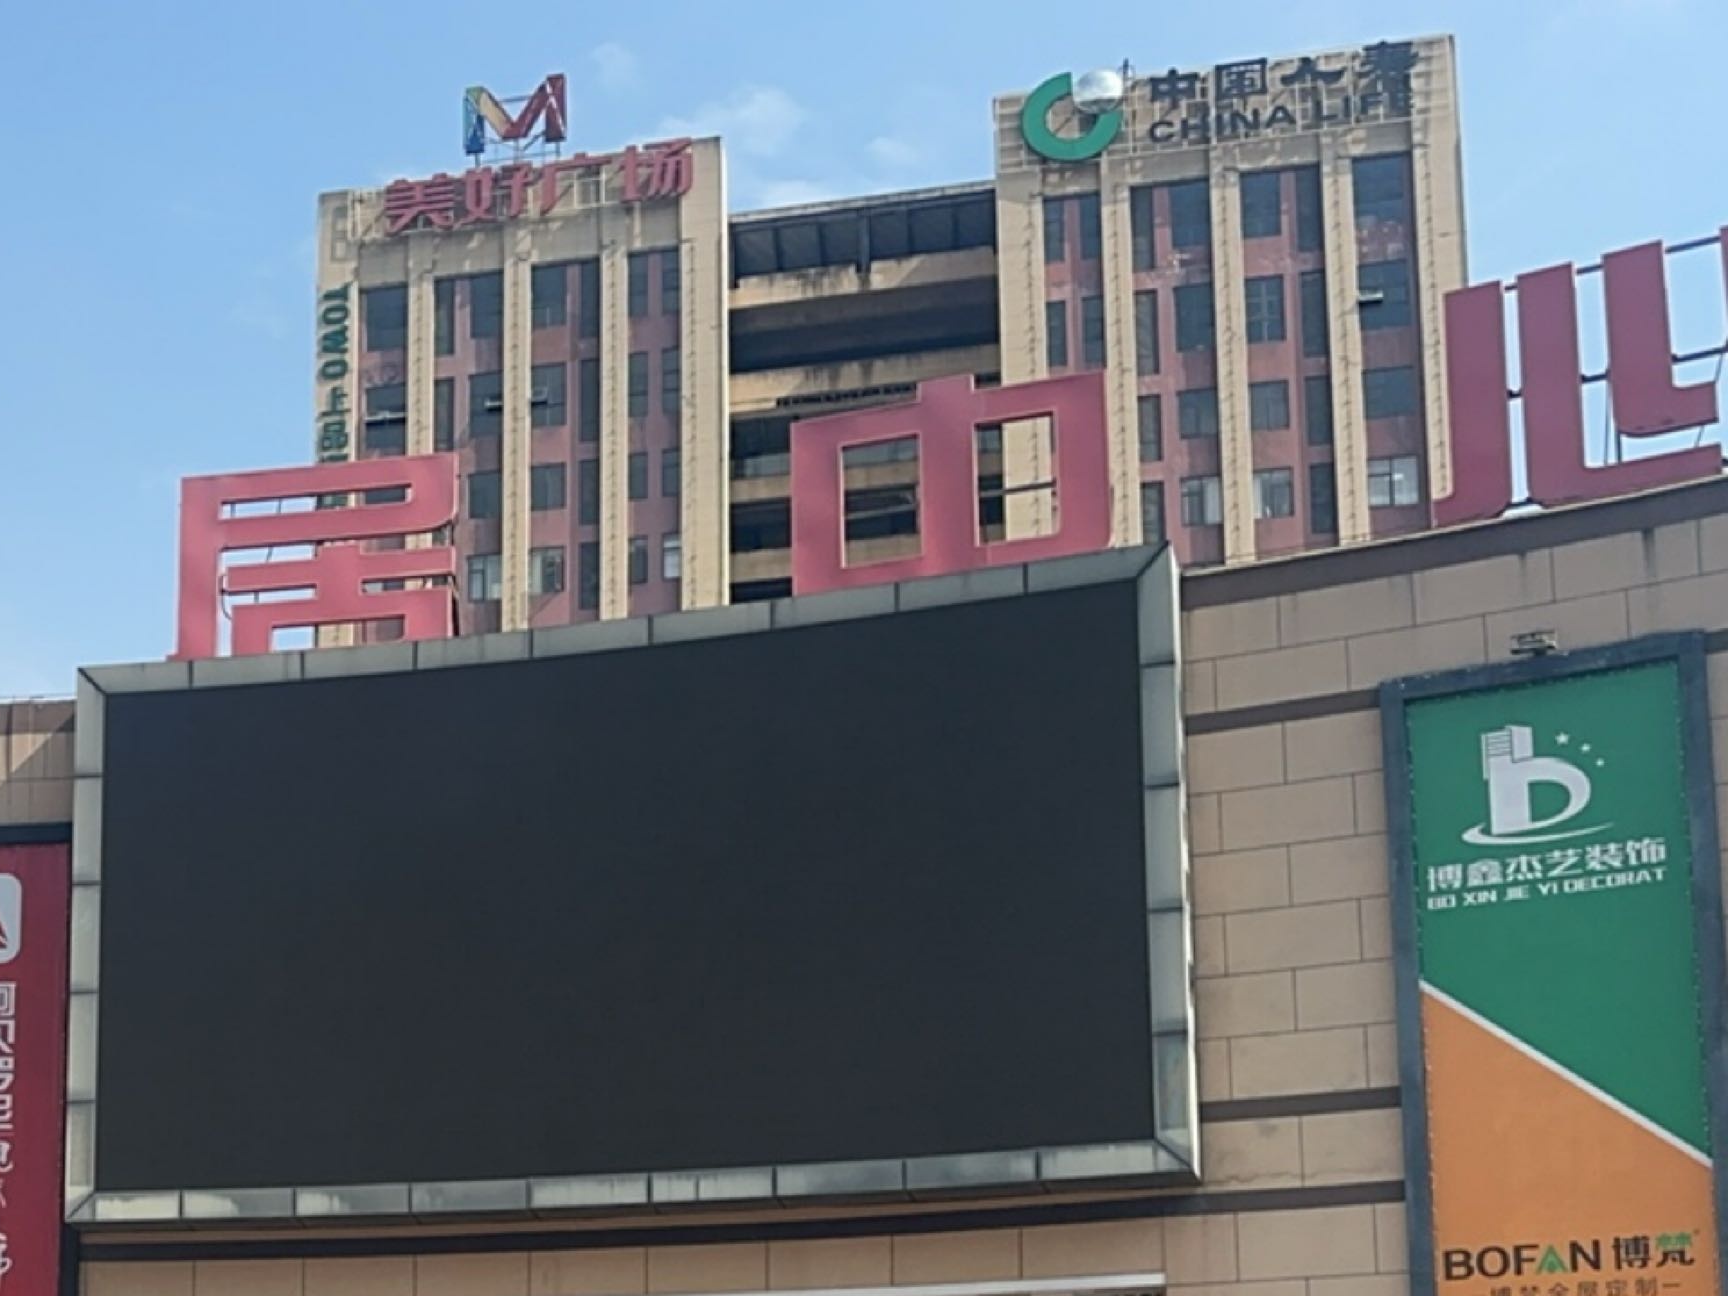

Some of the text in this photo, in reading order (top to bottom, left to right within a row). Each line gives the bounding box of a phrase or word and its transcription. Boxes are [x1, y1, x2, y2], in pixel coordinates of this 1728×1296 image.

[1149, 105, 1296, 143] CHINA
[384, 138, 693, 234] 美好广场
[1426, 837, 1668, 892] 博鑫杰艺装饰
[1462, 889, 1498, 907] XIN
[1443, 1239, 1601, 1281] BOFAN
